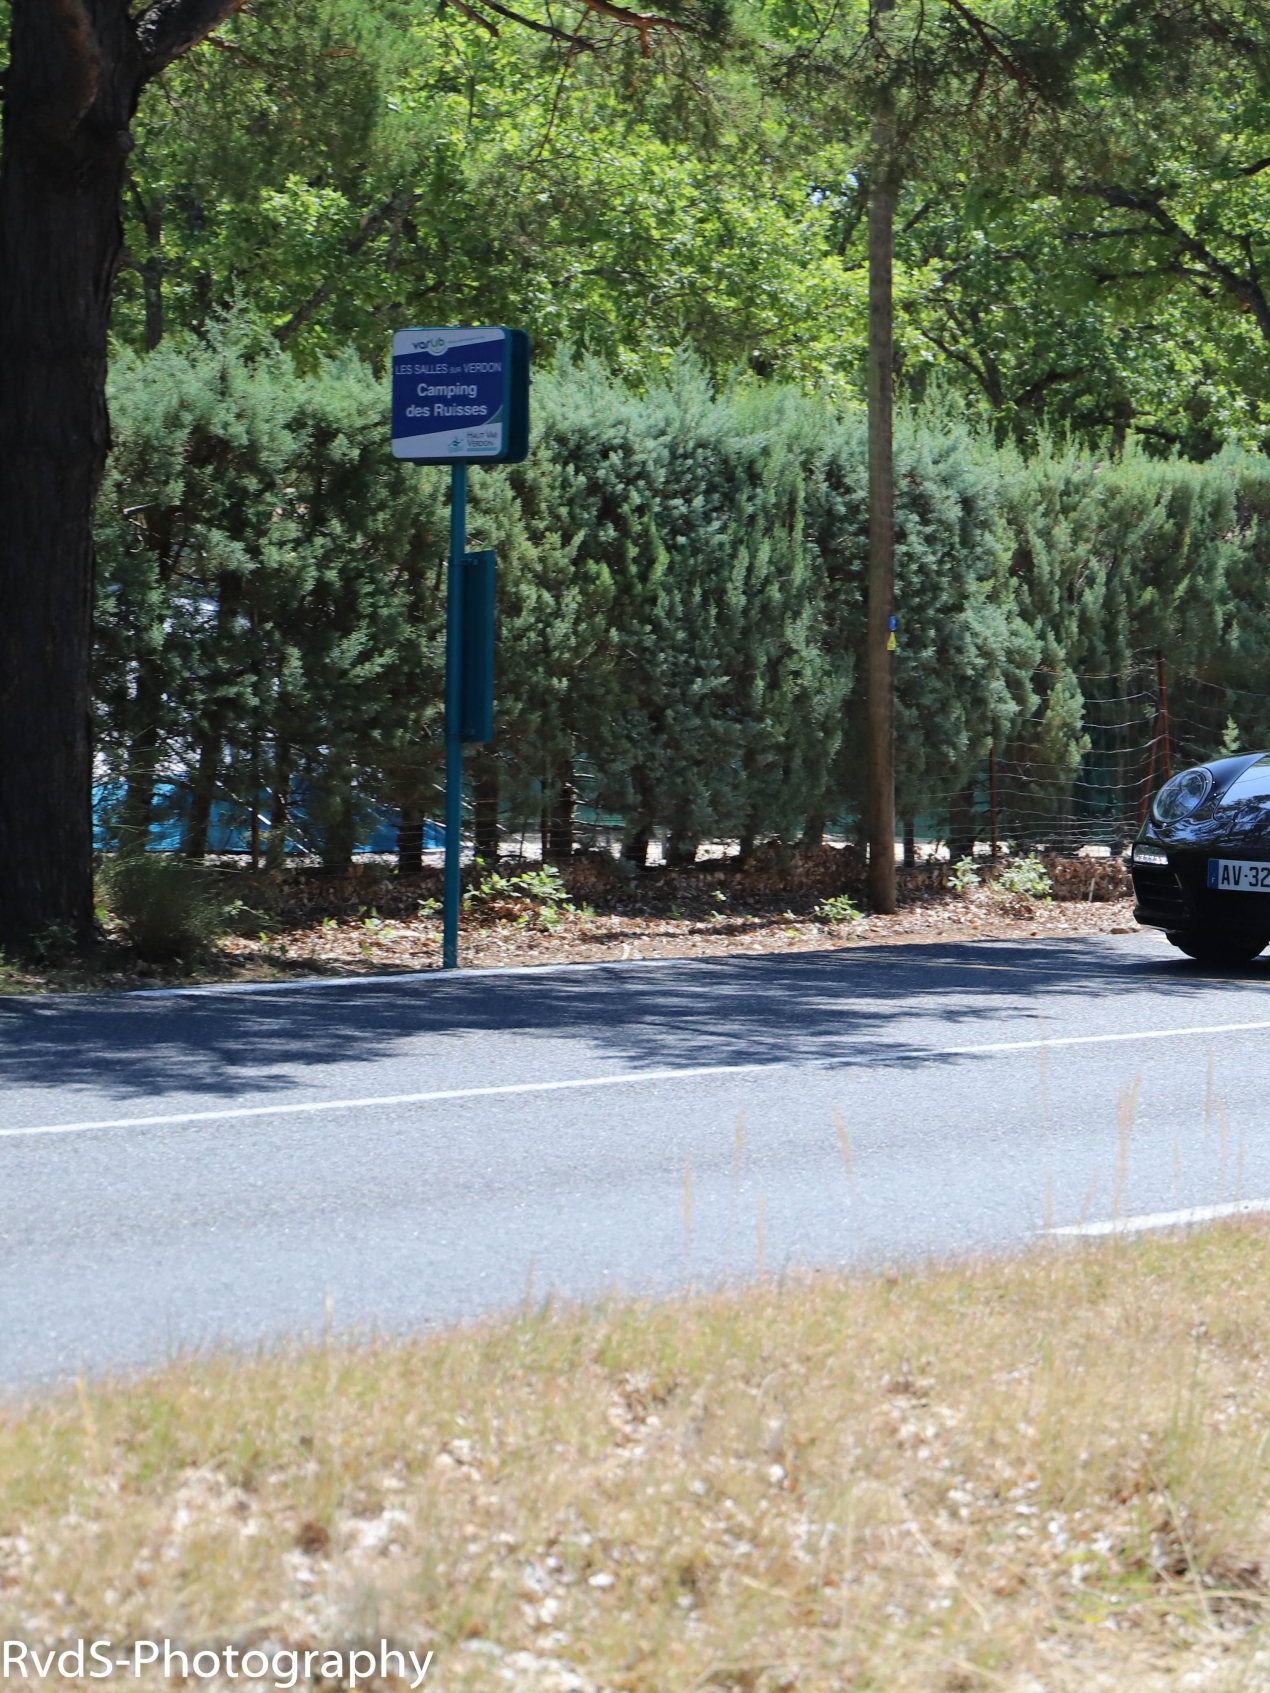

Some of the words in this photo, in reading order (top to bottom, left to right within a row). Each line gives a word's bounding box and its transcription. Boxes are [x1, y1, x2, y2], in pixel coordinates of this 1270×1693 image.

[395, 365, 412, 375] LES
[414, 364, 448, 374] SALLES
[463, 362, 501, 373] VERDON
[417, 383, 478, 398] Camping
[406, 405, 430, 417] des
[434, 404, 488, 416] Ruisses
